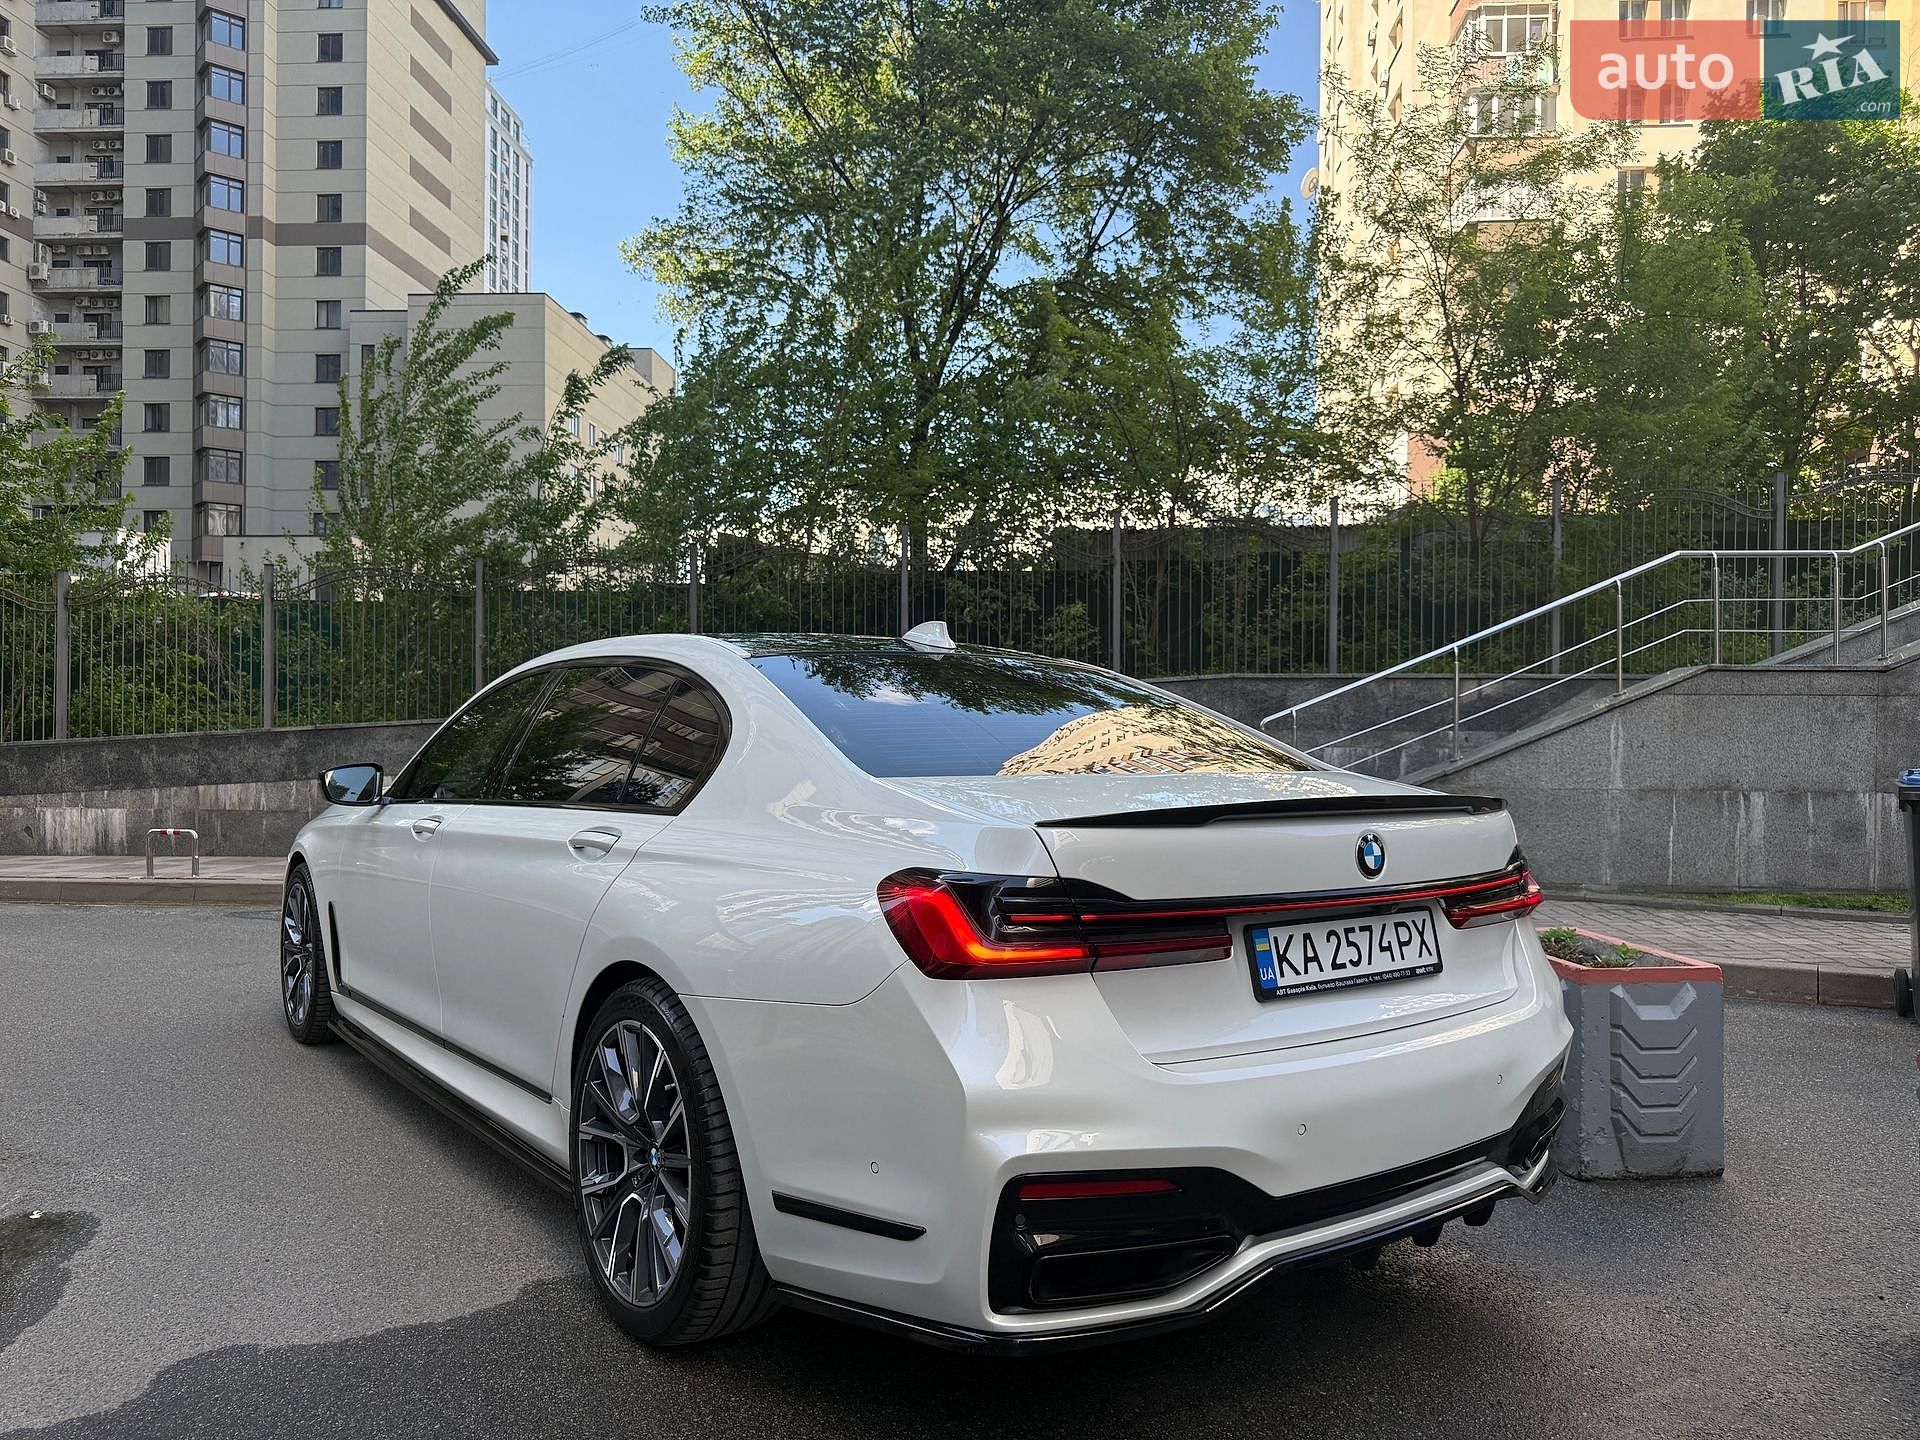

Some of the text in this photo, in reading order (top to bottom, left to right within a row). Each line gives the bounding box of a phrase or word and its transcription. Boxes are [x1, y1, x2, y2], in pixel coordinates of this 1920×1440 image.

[1273, 919, 1433, 978] KA 2574 PX
[1260, 967, 1275, 981] UA
